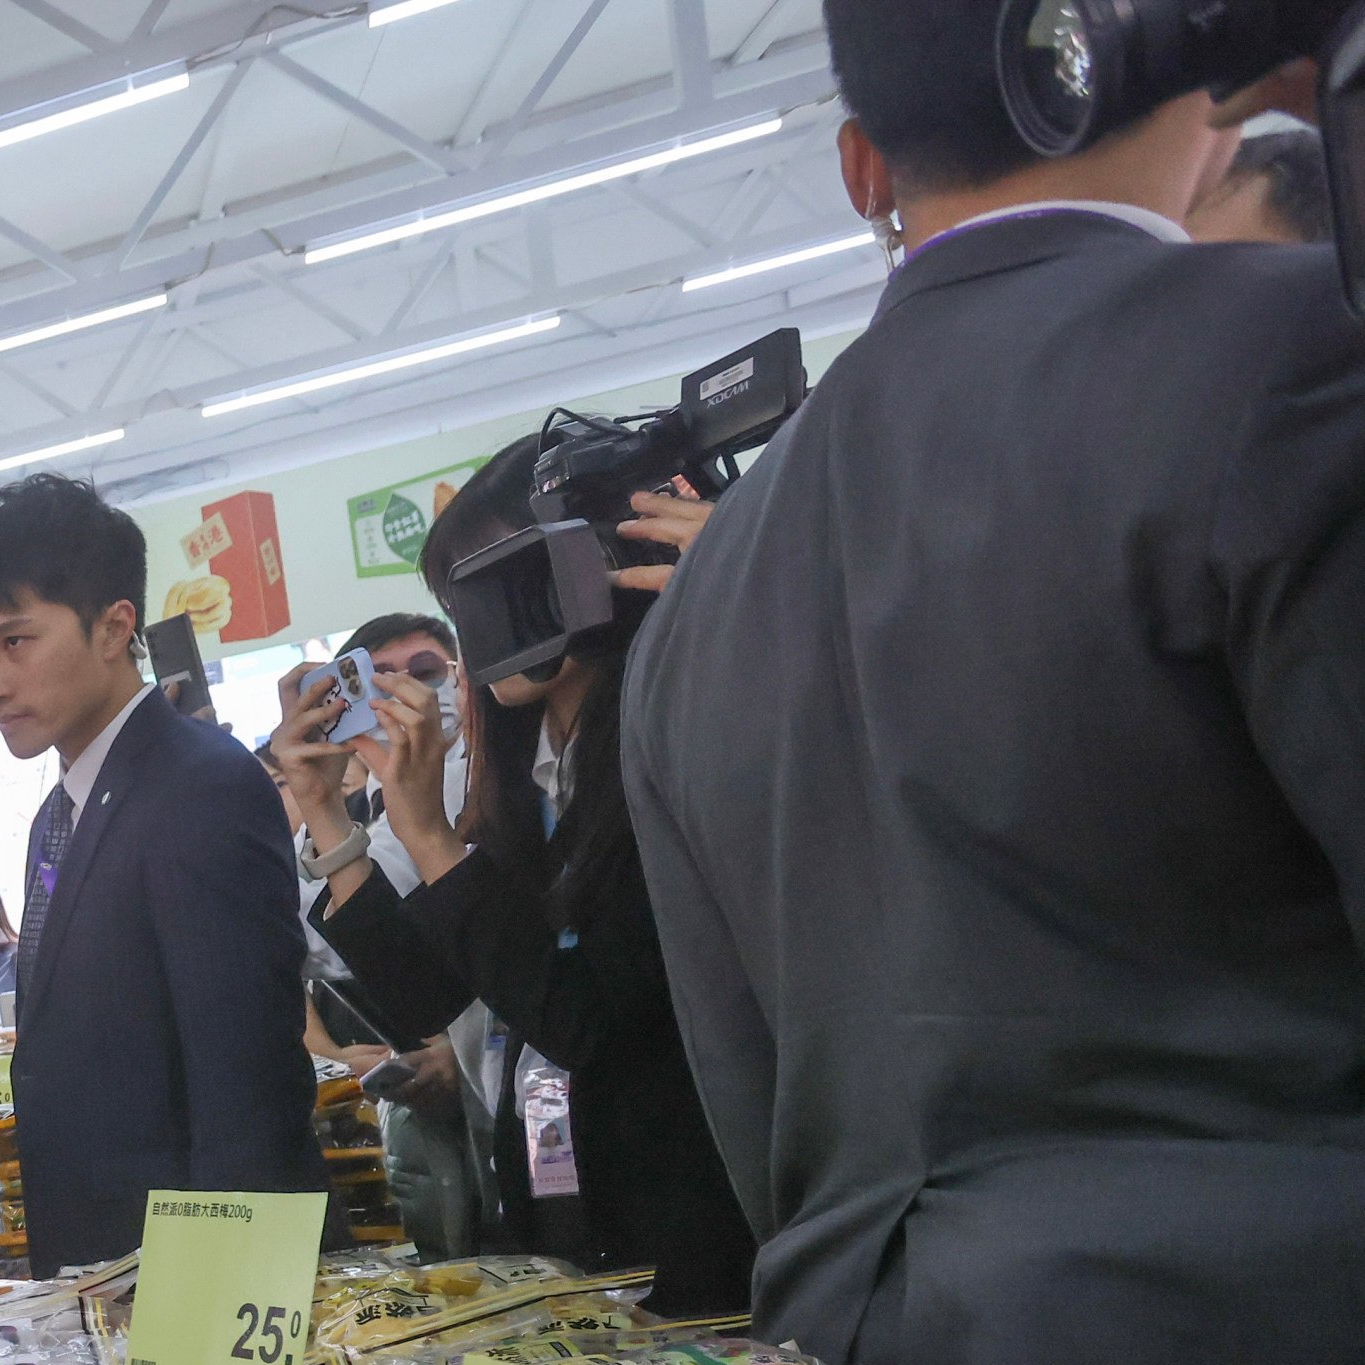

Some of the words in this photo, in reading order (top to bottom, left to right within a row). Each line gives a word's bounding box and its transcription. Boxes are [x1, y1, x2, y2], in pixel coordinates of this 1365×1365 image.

[706, 380, 749, 408] XDCAM
[152, 1202, 253, 1223] 自然派0脂肪大西梅200g
